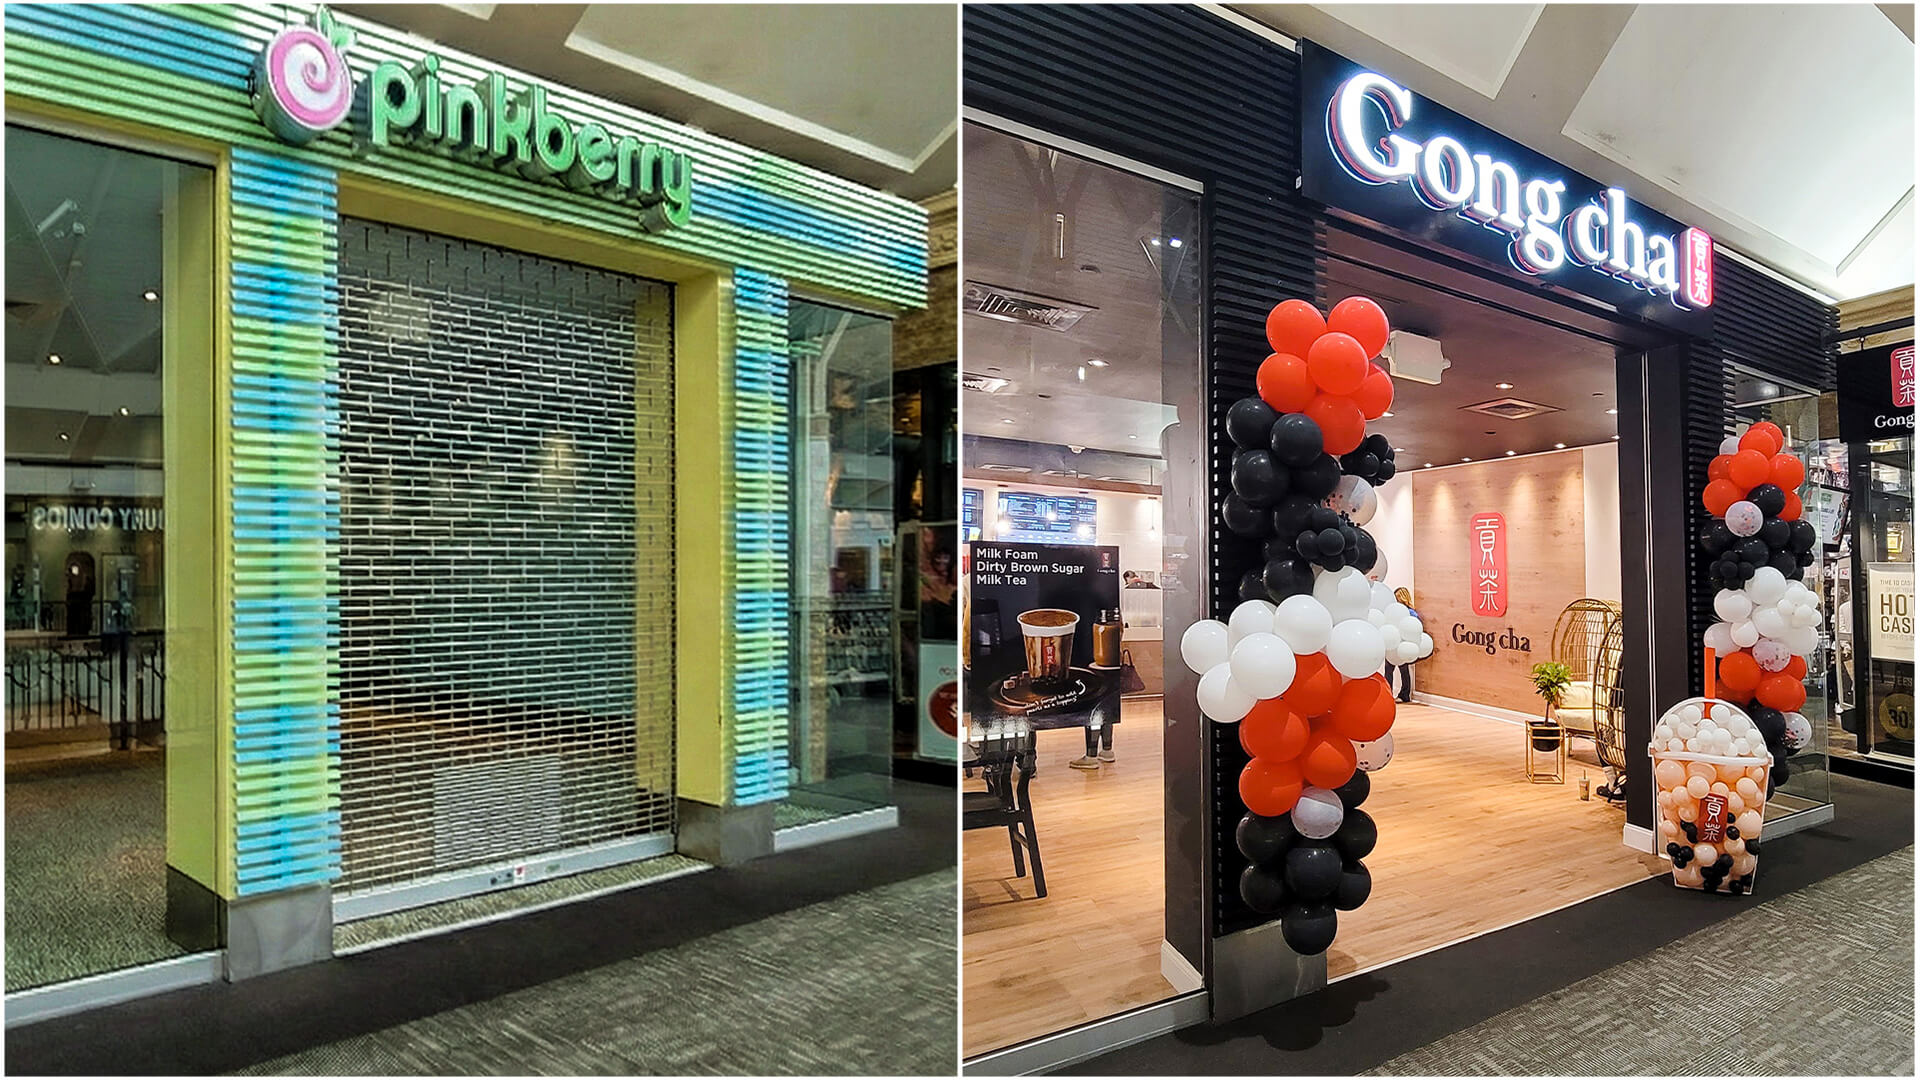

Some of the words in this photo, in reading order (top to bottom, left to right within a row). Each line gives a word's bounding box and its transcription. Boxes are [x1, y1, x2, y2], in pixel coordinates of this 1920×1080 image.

[371, 53, 692, 229] pinkberry
[1328, 72, 1567, 273] Gong
[1568, 187, 1680, 293] cha
[976, 547, 1001, 560] Milk
[1005, 549, 1038, 560] Foam
[976, 561, 1007, 573] Dirty
[1010, 563, 1048, 573] Brown
[1051, 563, 1084, 575] Sugar
[1475, 518, 1499, 611] 貢茶
[976, 574, 1001, 585] Milk
[1005, 575, 1027, 585] Tea
[1452, 623, 1496, 655] Gong
[1499, 627, 1531, 652] cha
